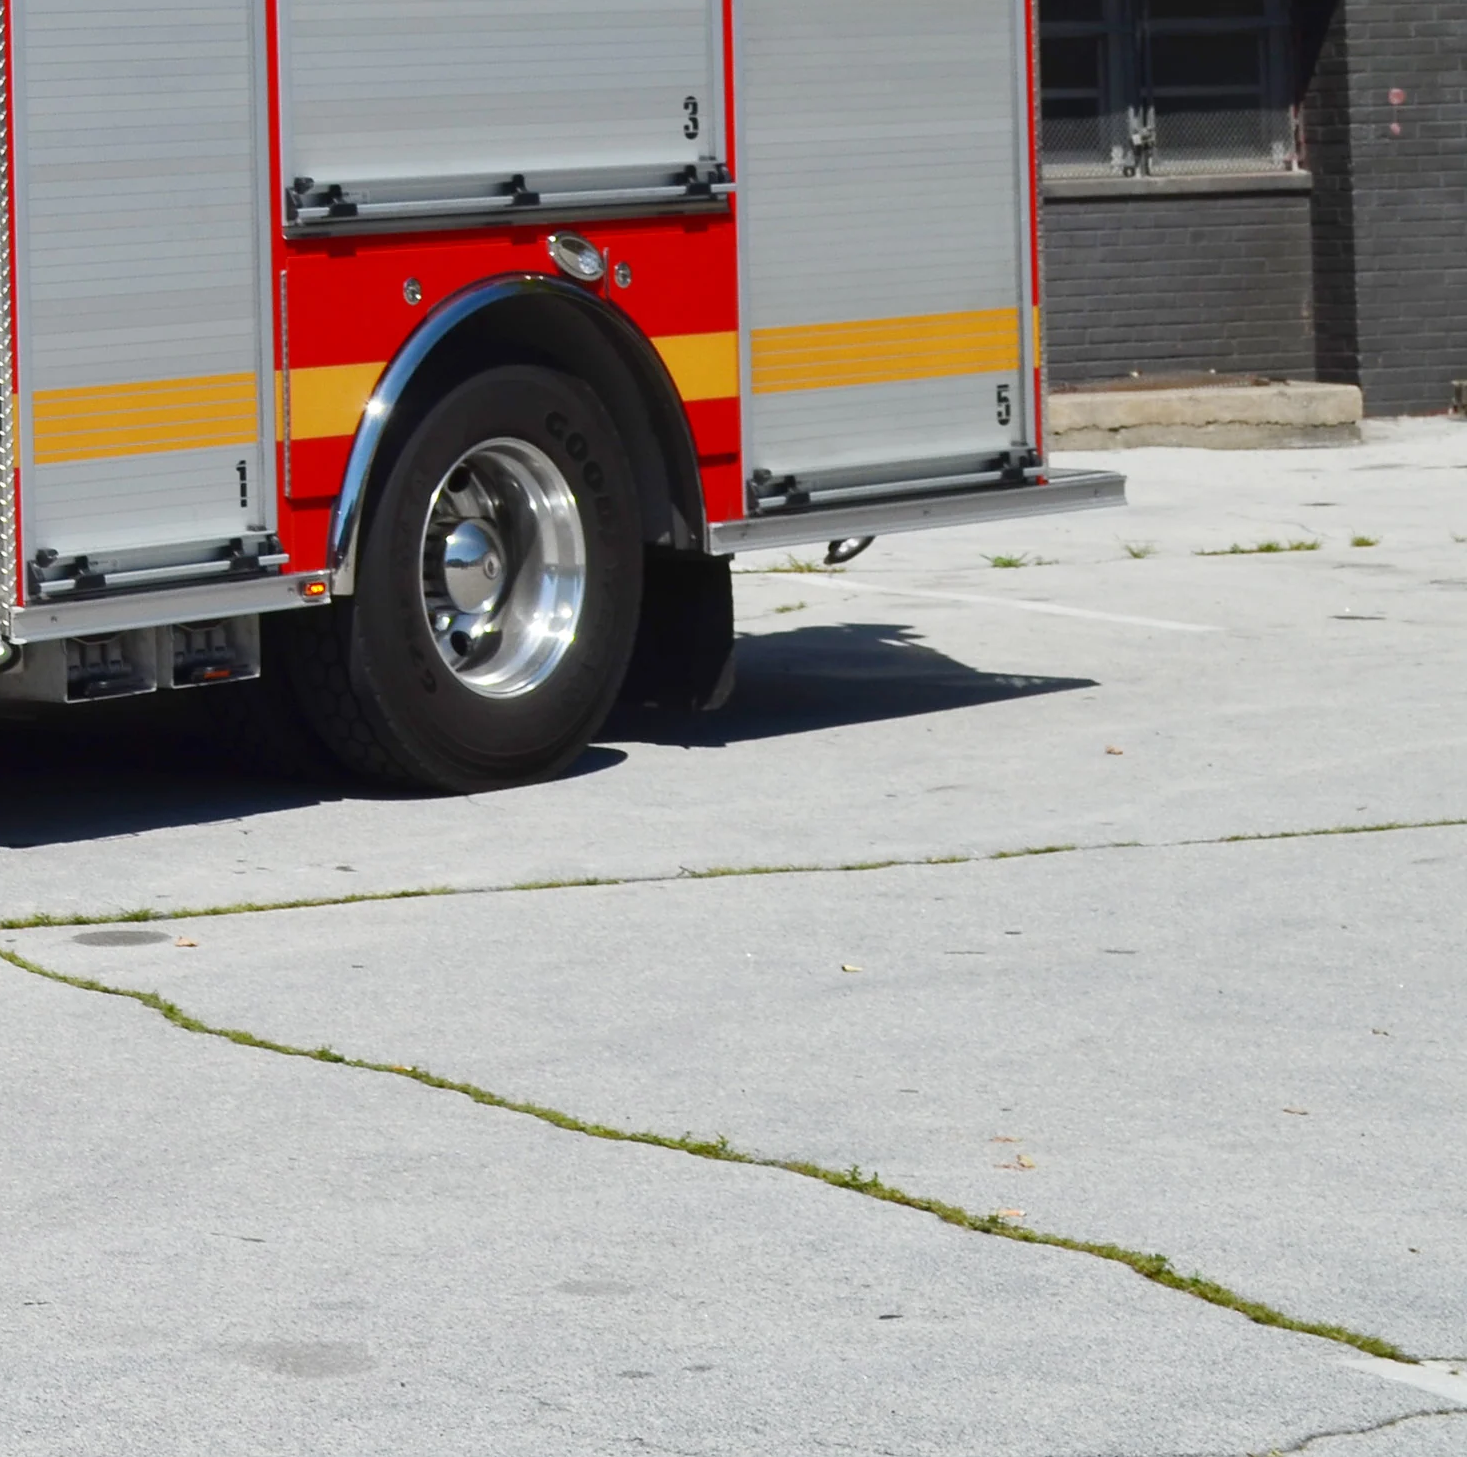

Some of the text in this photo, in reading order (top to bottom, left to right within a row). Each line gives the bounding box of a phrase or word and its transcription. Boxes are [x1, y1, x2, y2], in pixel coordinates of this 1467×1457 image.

[683, 96, 699, 140] 3
[997, 385, 1011, 426] 5
[236, 460, 247, 507] 1
